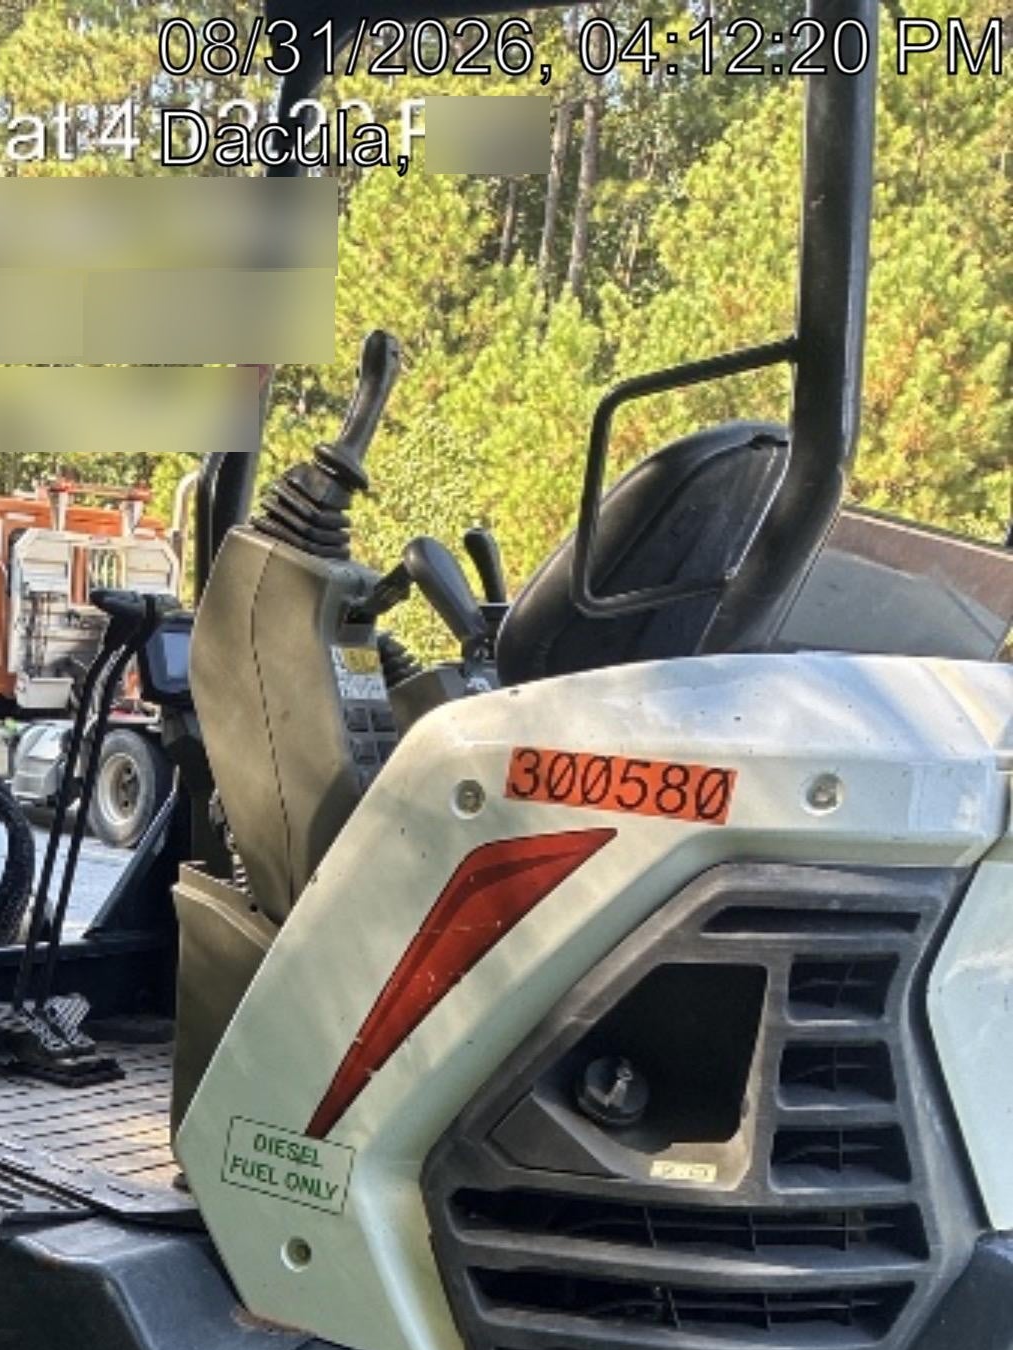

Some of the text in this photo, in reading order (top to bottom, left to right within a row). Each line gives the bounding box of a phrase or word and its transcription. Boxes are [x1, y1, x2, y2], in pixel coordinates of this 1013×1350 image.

[510, 747, 732, 820] 300580
[253, 1133, 323, 1169] DIESEL
[229, 1154, 339, 1201] FUEL ONLY
